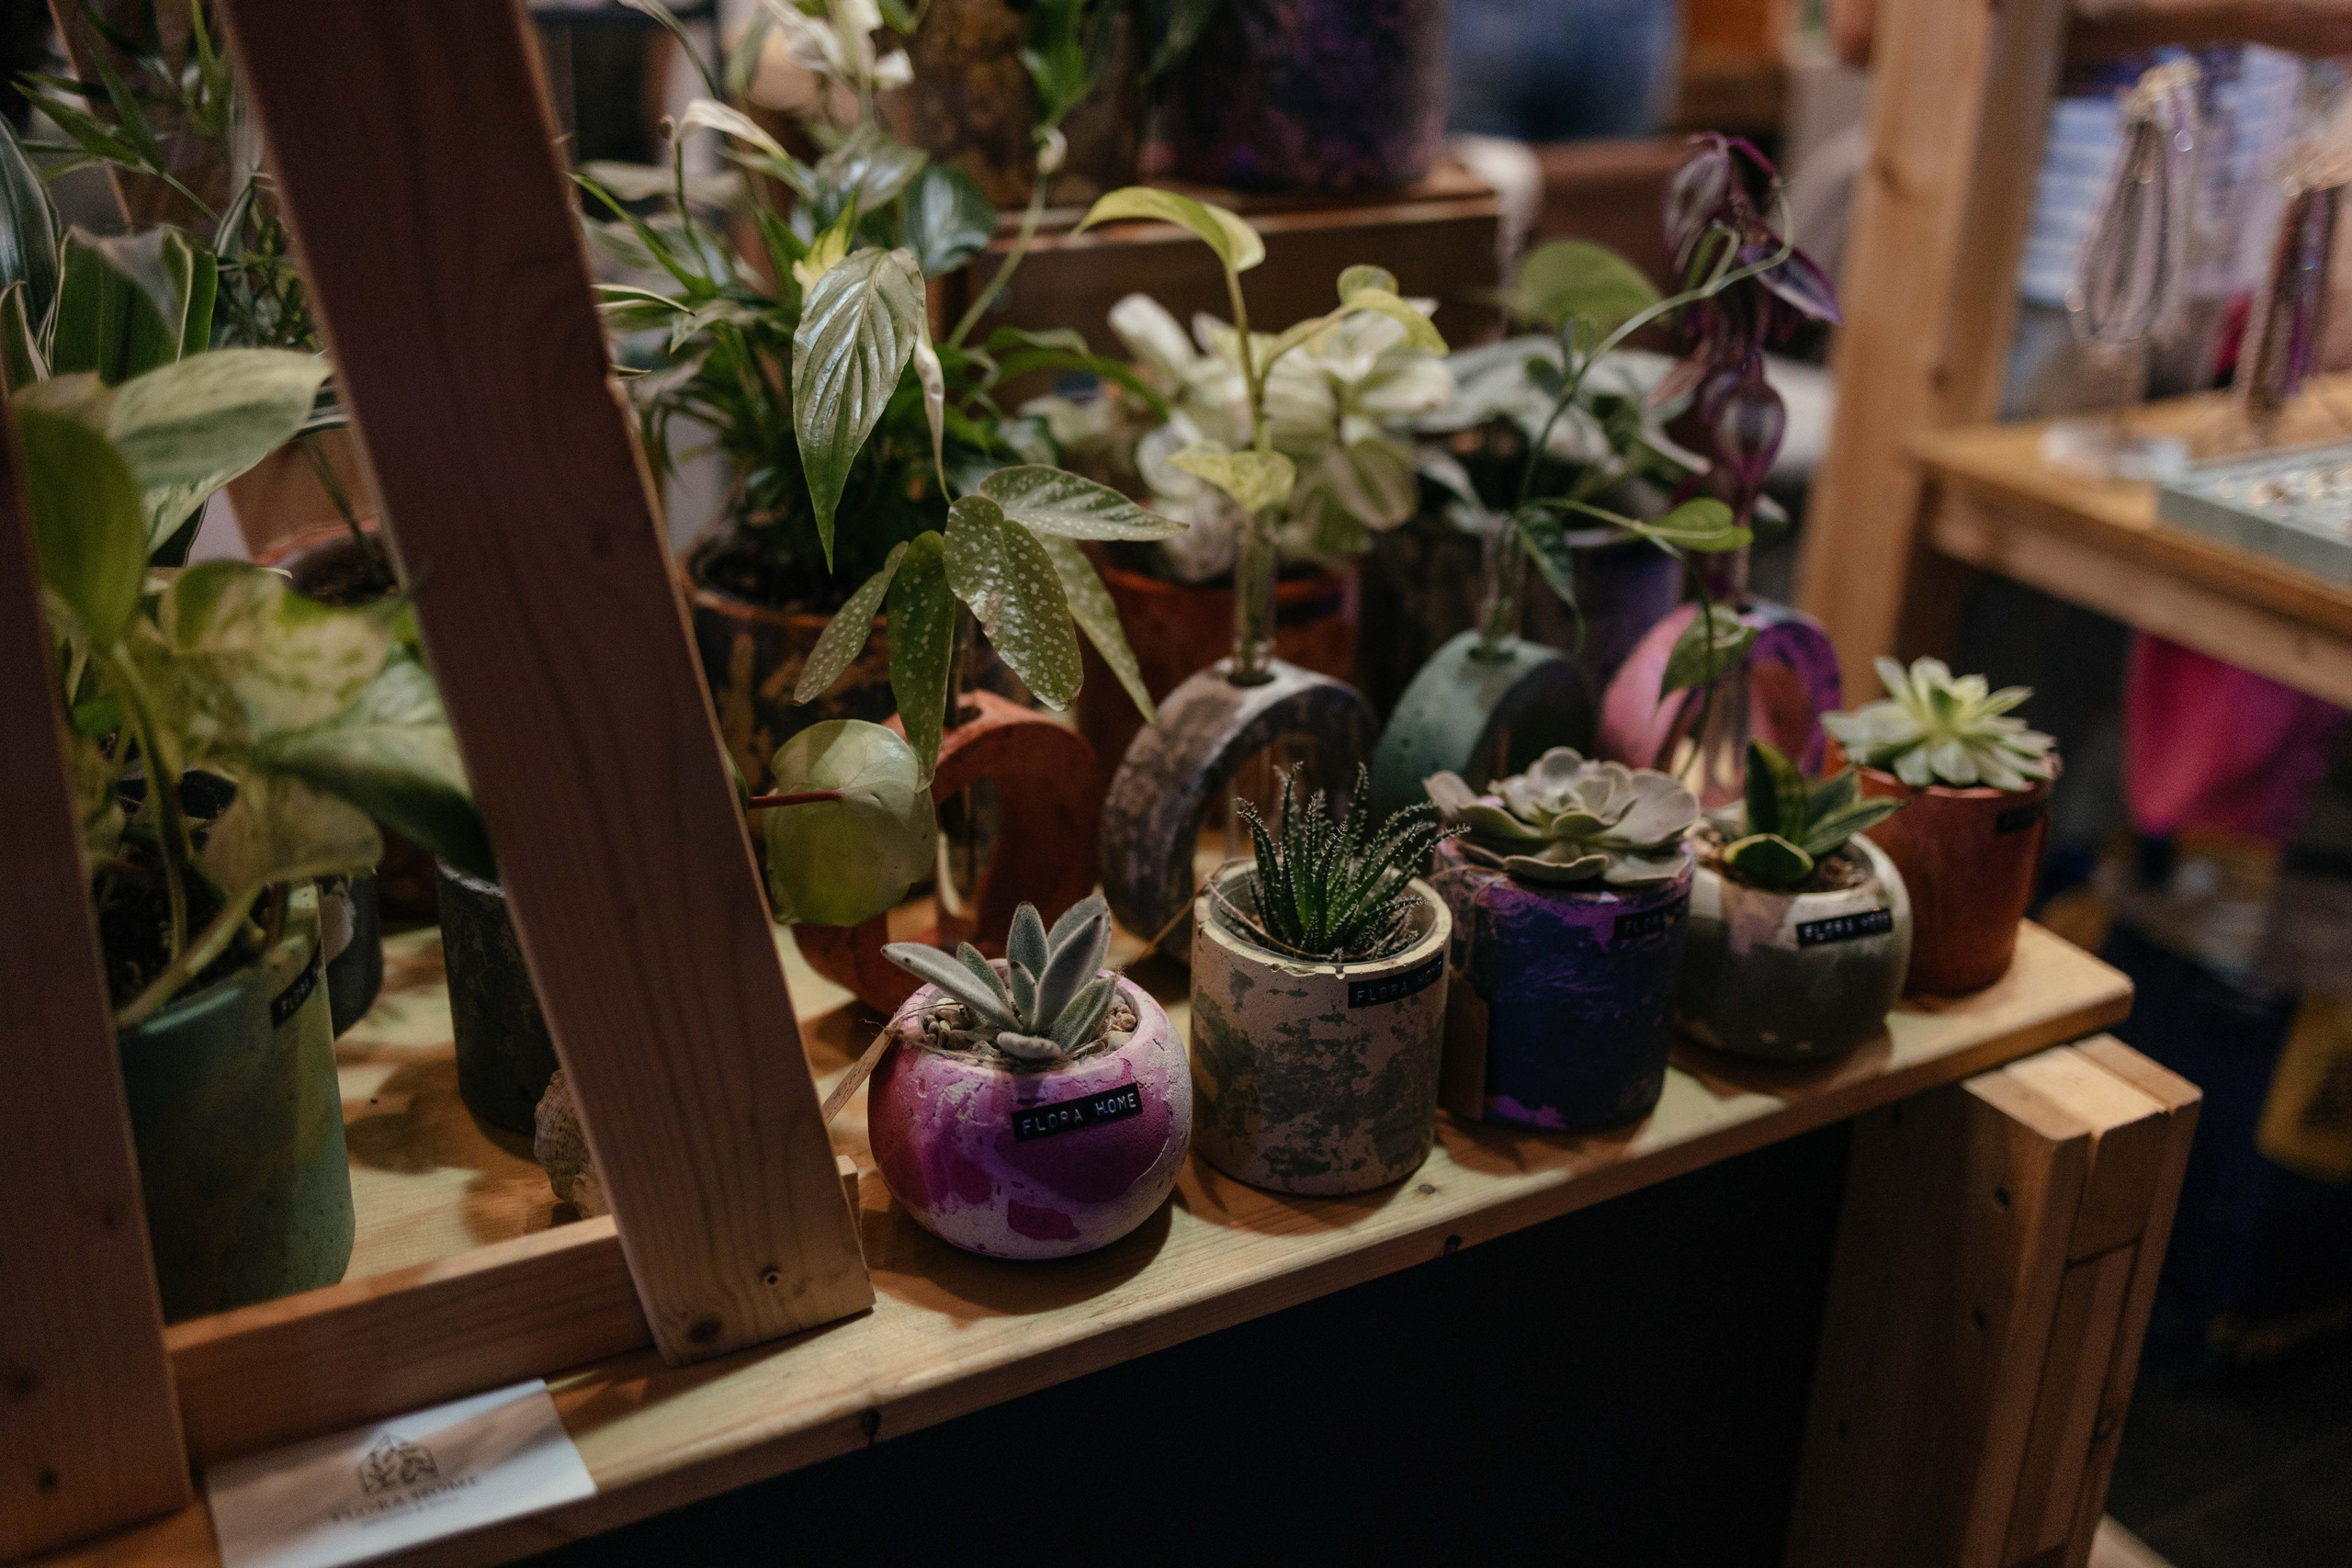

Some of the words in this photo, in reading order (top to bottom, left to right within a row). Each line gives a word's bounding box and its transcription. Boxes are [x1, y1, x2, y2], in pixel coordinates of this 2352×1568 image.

[1357, 980, 1408, 1003] FLORA
[1022, 1108, 1083, 1135] FLORA
[1095, 1092, 1137, 1117] HOME
